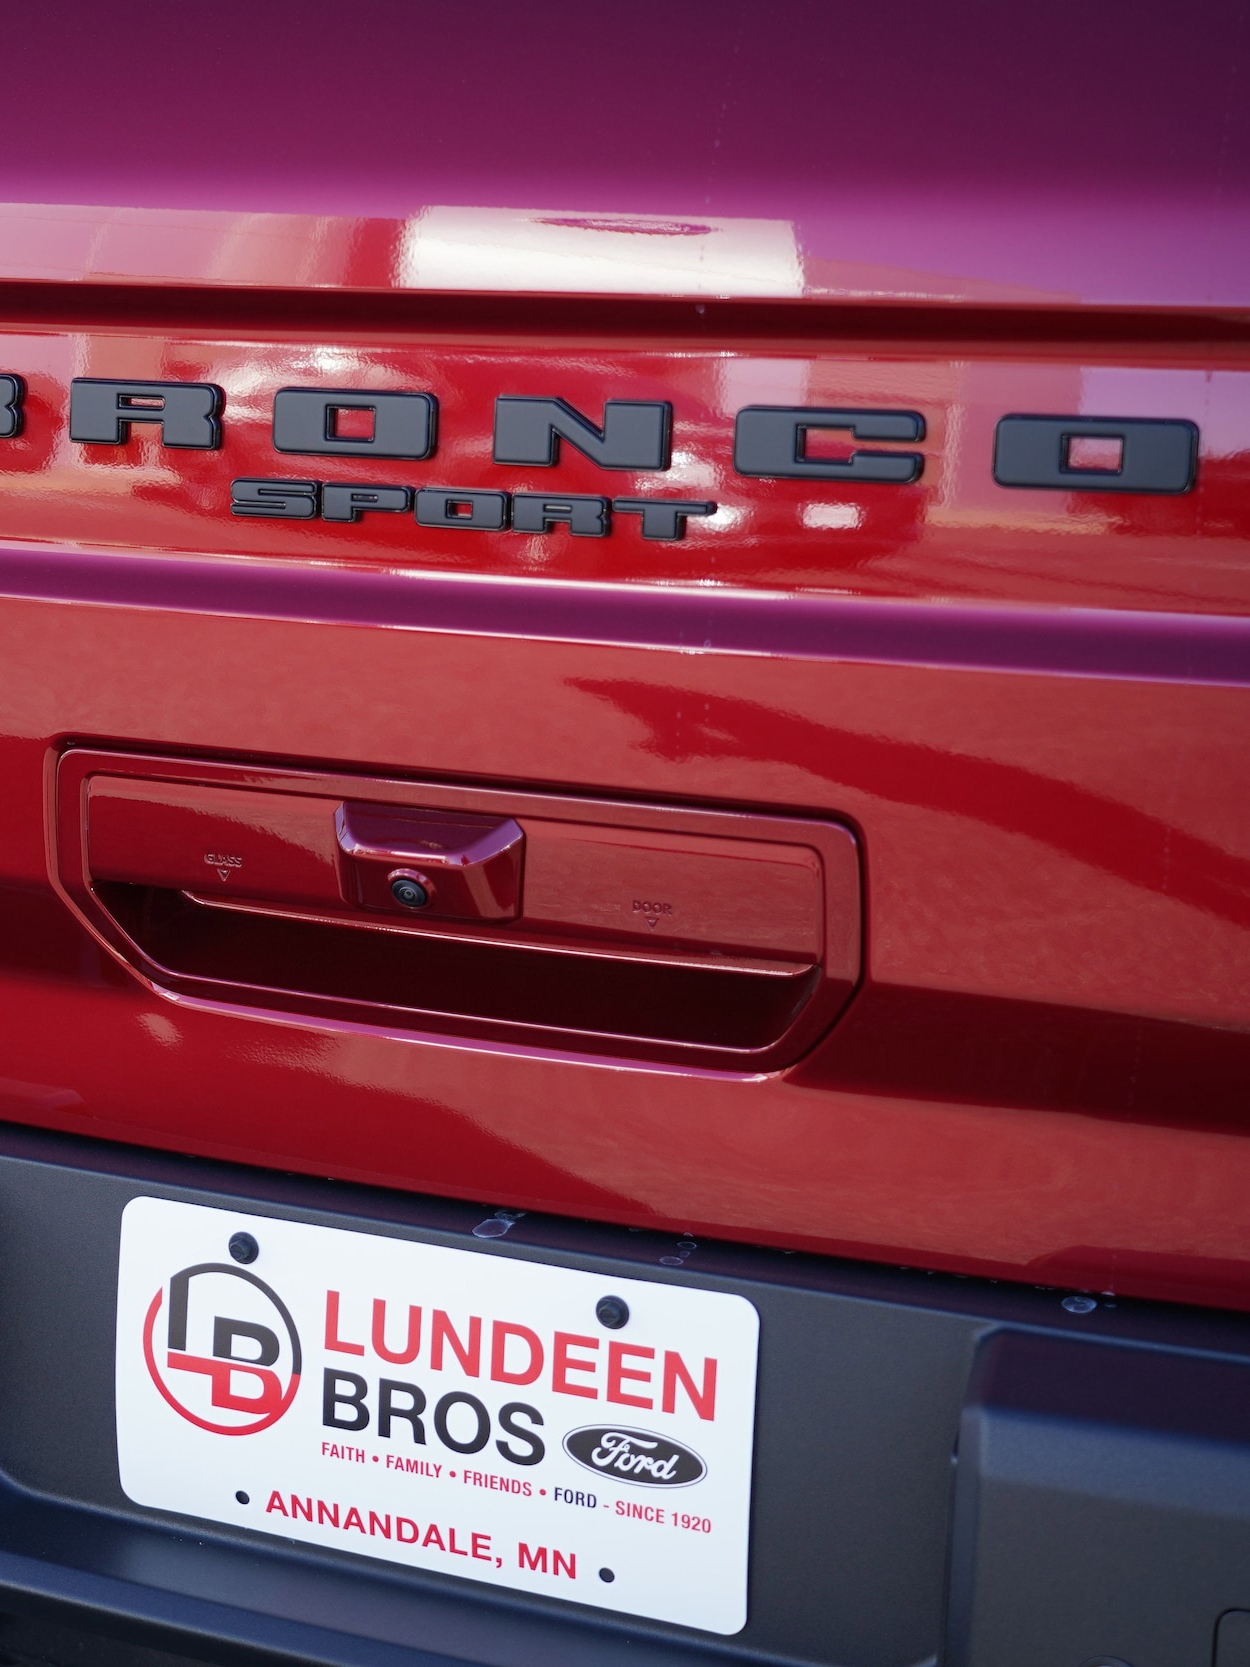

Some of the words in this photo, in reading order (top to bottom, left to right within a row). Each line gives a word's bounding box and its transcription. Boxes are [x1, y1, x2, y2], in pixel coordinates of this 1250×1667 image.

[230, 476, 718, 542] SPORT
[203, 852, 243, 868] GLASS
[631, 899, 673, 917] DOOR
[323, 1288, 718, 1422] LUNDEEN
[321, 1366, 547, 1467] BROS
[590, 1431, 678, 1481] Ford
[321, 1441, 366, 1464] FAITH
[385, 1454, 444, 1479] FAMILY
[462, 1469, 534, 1498] FRIENDS
[553, 1486, 598, 1509] FORD
[614, 1500, 667, 1525] SINCE
[670, 1511, 713, 1534] 1920
[265, 1489, 504, 1569] ANNANDALE,
[517, 1541, 578, 1581] MN
